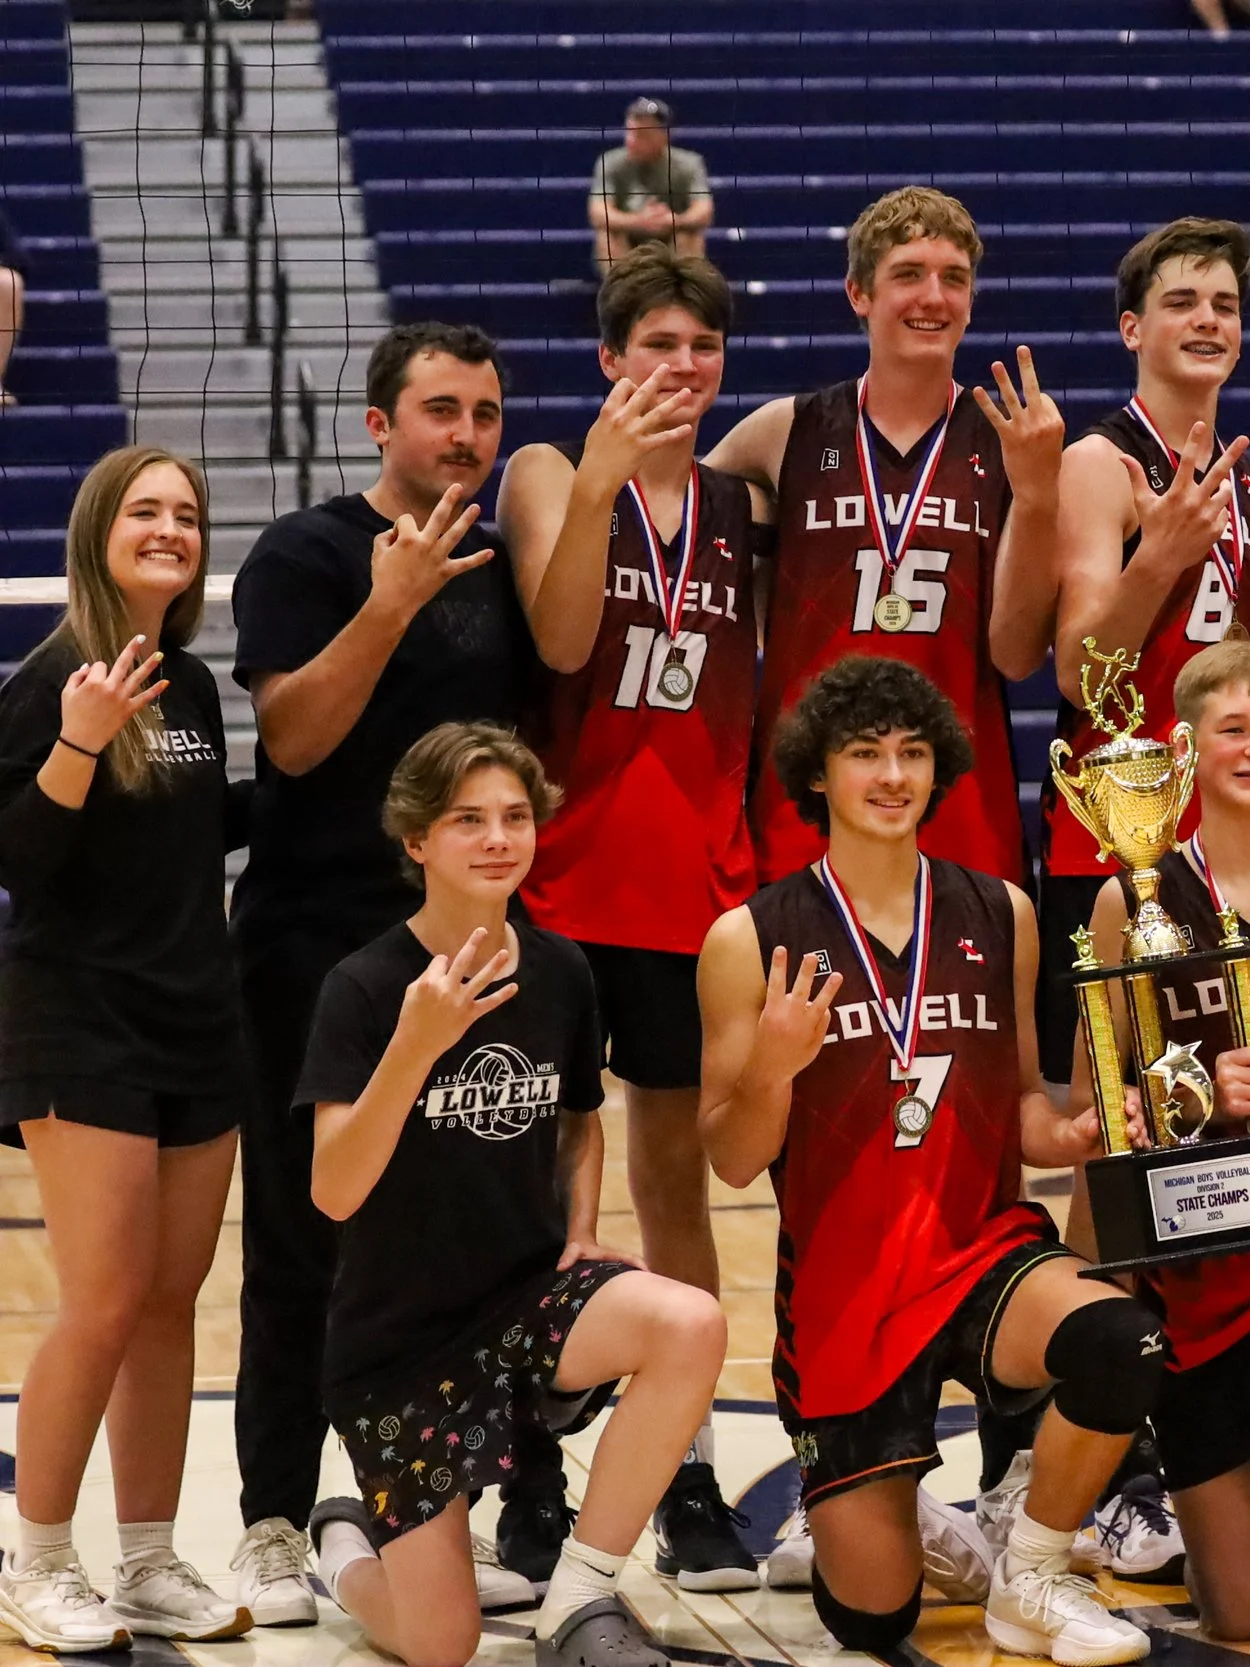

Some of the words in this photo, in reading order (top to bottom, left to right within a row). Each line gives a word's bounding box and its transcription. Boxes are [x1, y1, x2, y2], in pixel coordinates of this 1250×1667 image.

[853, 549, 951, 632] 15
[1186, 560, 1236, 642] 8
[614, 624, 708, 711] 10
[437, 1073, 466, 1084] 2024
[439, 1079, 552, 1114] LOWELL
[890, 1054, 953, 1148] 7
[1164, 1175, 1195, 1188] MICHIGAN
[1197, 1172, 1214, 1183] BOYS
[1197, 1184, 1220, 1194] DIVISION
[1221, 1182, 1225, 1190] 2
[1176, 1195, 1206, 1213] STATE
[1208, 1188, 1249, 1208] CHAMPS
[1207, 1210, 1224, 1221] 2025
